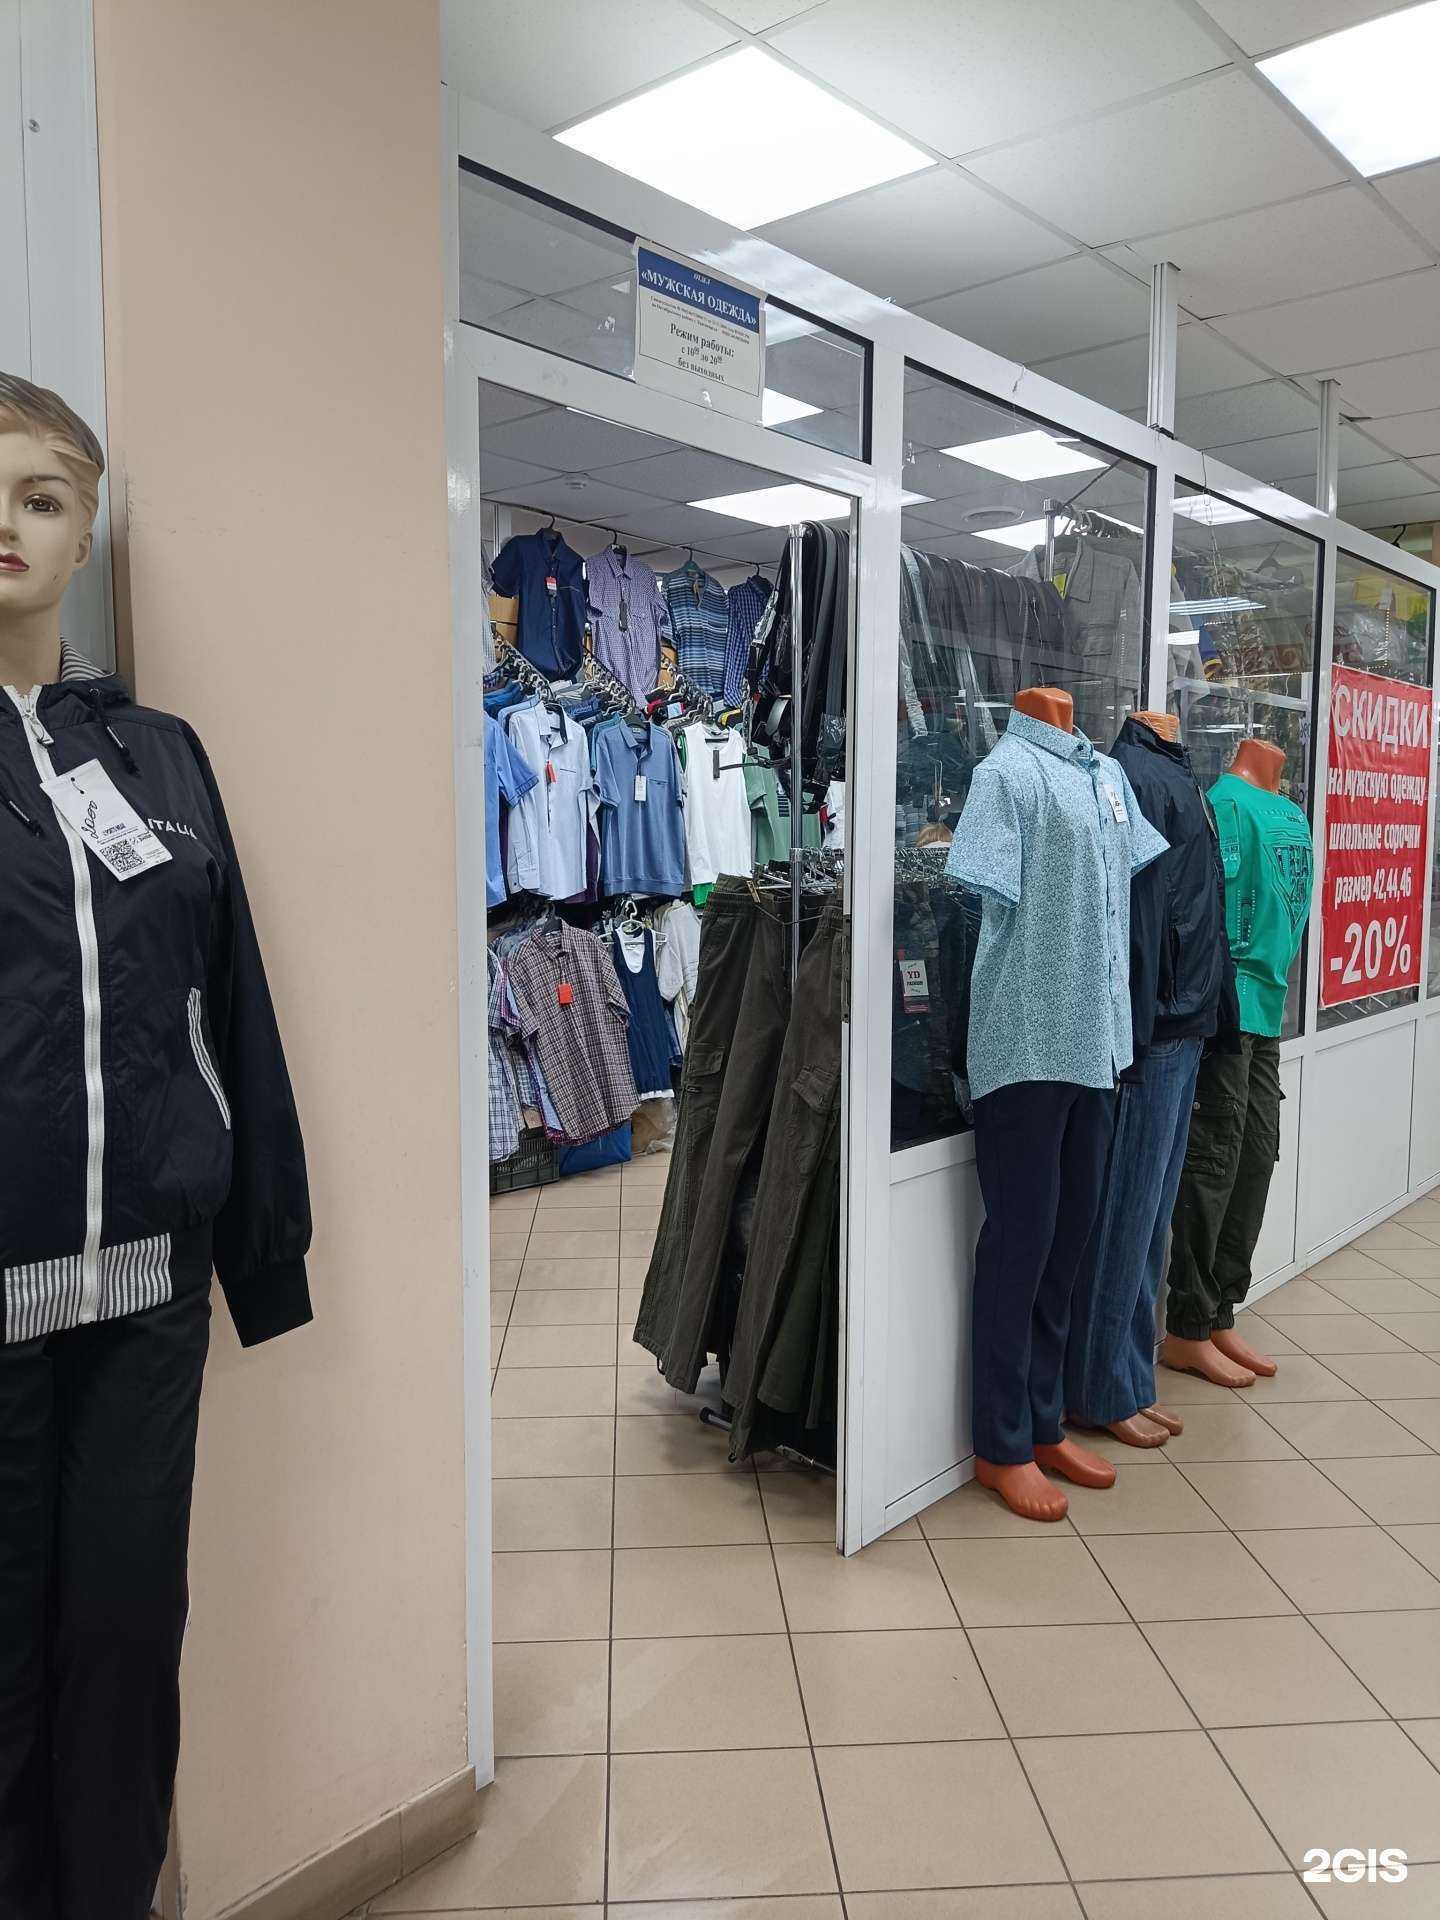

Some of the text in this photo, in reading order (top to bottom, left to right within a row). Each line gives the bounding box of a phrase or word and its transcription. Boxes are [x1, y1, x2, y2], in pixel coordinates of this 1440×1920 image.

[641, 269, 705, 304] «МУЖСКАЯ
[707, 295, 757, 325] ОДЕЖДА»
[670, 323, 699, 344] Режим
[701, 338, 735, 358] работы:
[678, 357, 690, 369] без
[1333, 684, 1428, 755] СКИДКИ
[1328, 767, 1343, 796] на
[1344, 768, 1388, 804] мужскую
[1390, 773, 1427, 807] одежду
[1329, 823, 1421, 855] школьные сорочки
[1335, 866, 1412, 910] размер 42,44,46
[1330, 914, 1411, 985] -20%
